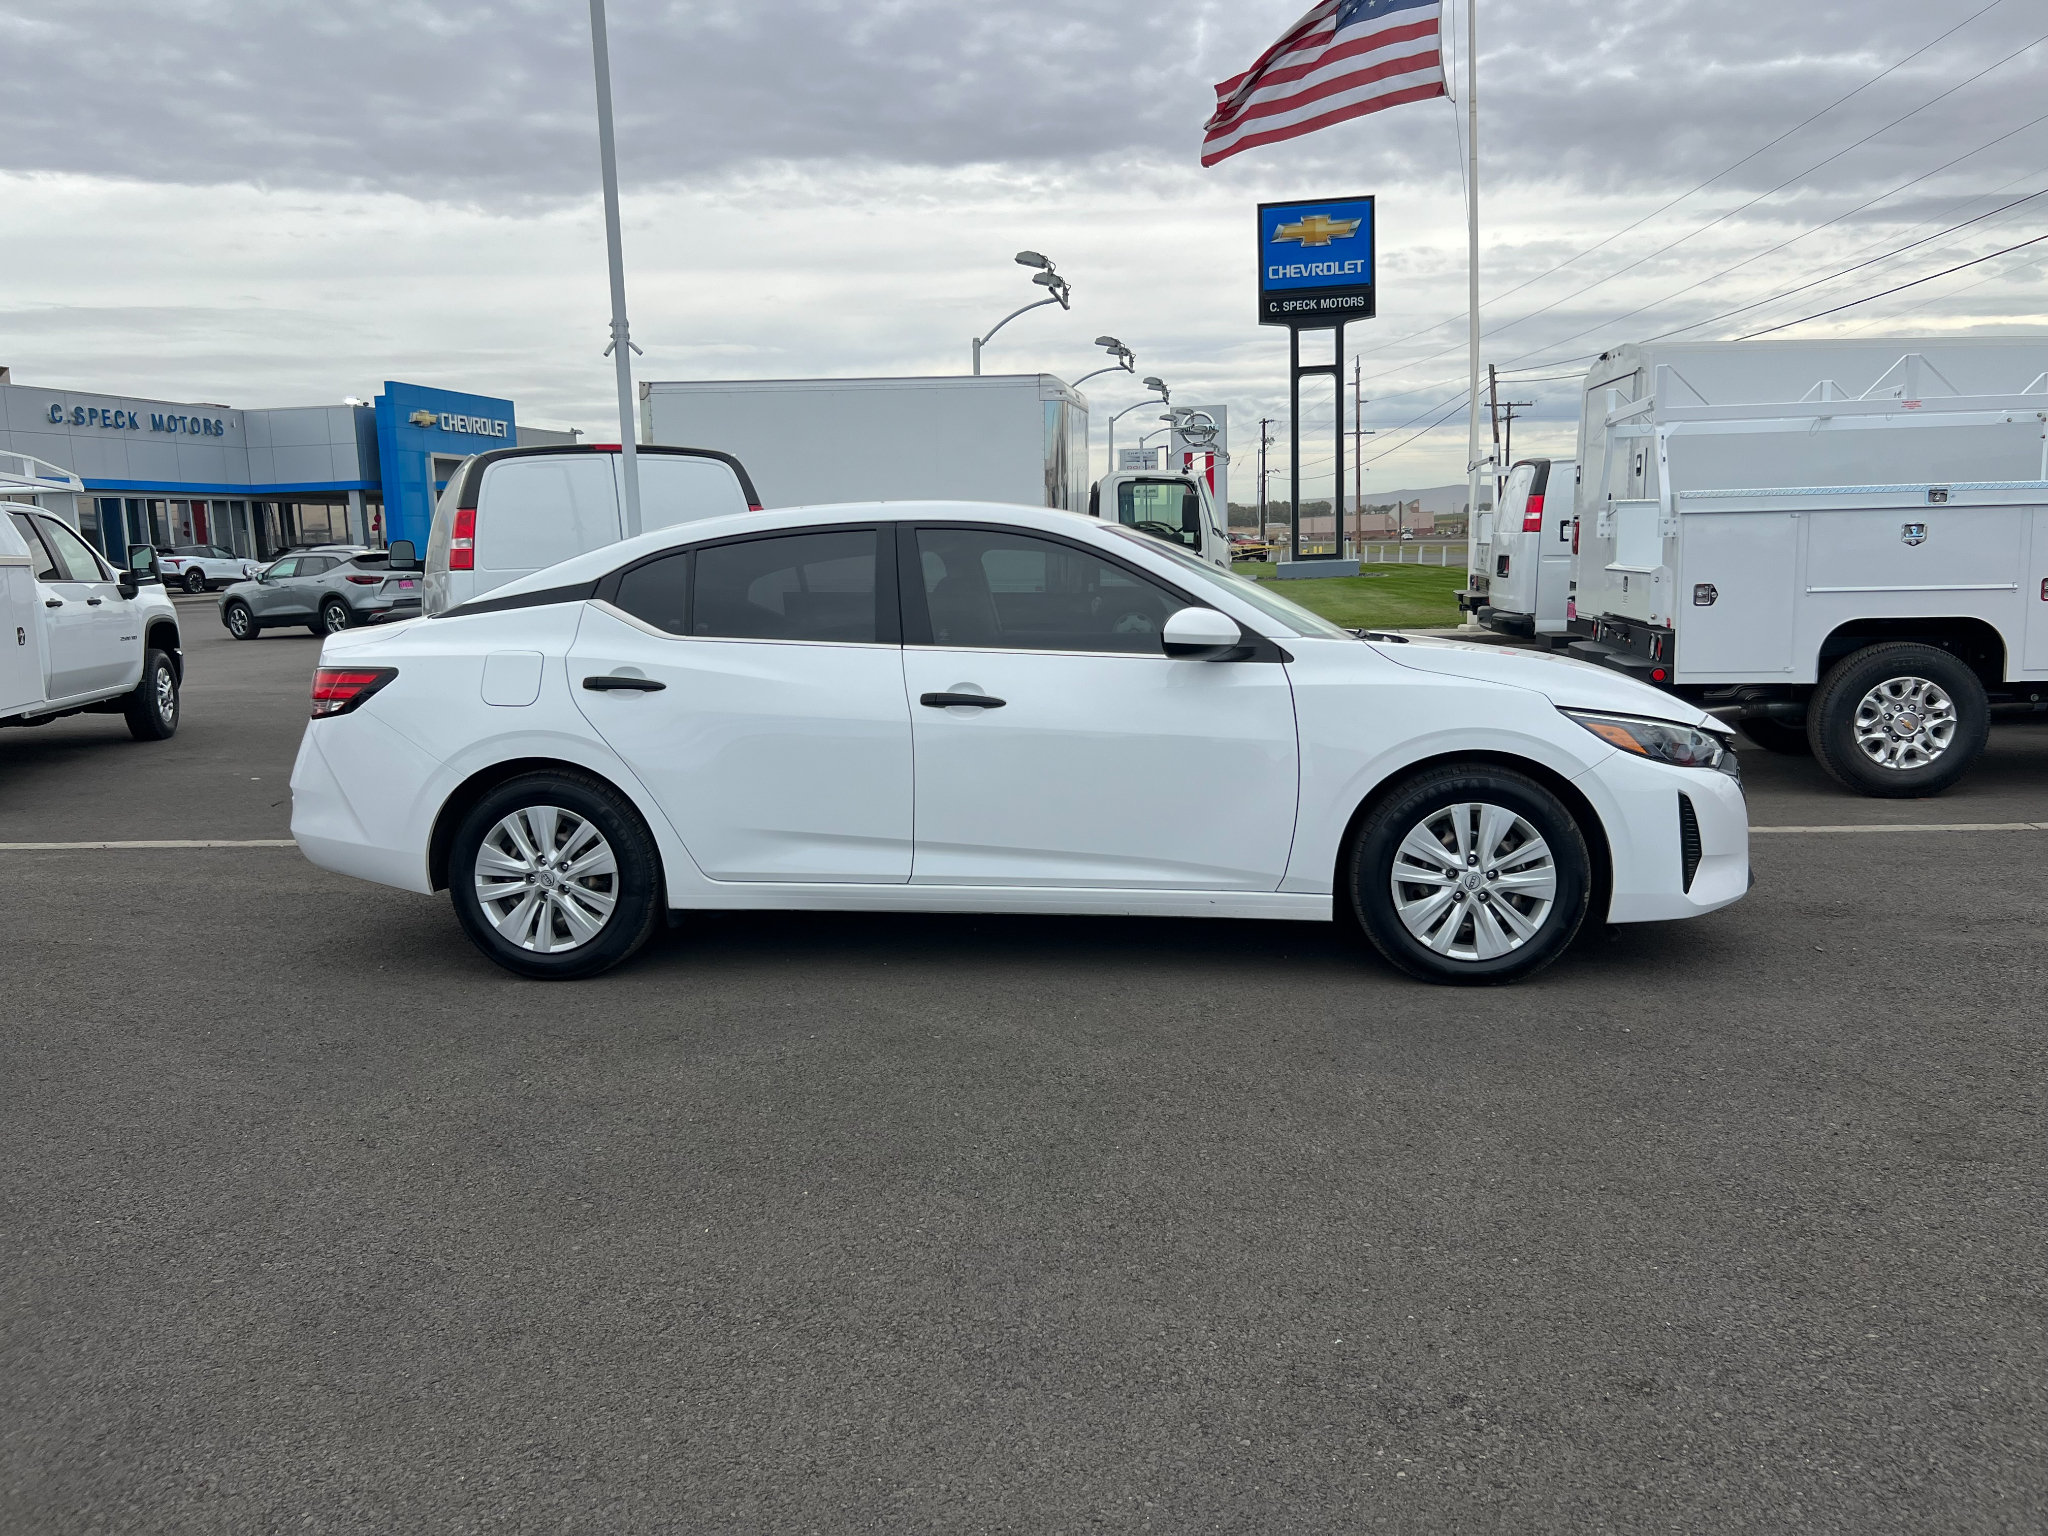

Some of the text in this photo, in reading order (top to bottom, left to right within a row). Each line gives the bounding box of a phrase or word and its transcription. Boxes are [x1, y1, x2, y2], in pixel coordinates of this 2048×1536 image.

[1268, 259, 1365, 279] CHEVROLET
[1269, 296, 1365, 312] C. SPECK MOTORS
[150, 412, 224, 436] MOTORS
[440, 412, 508, 437] CHEVROLET
